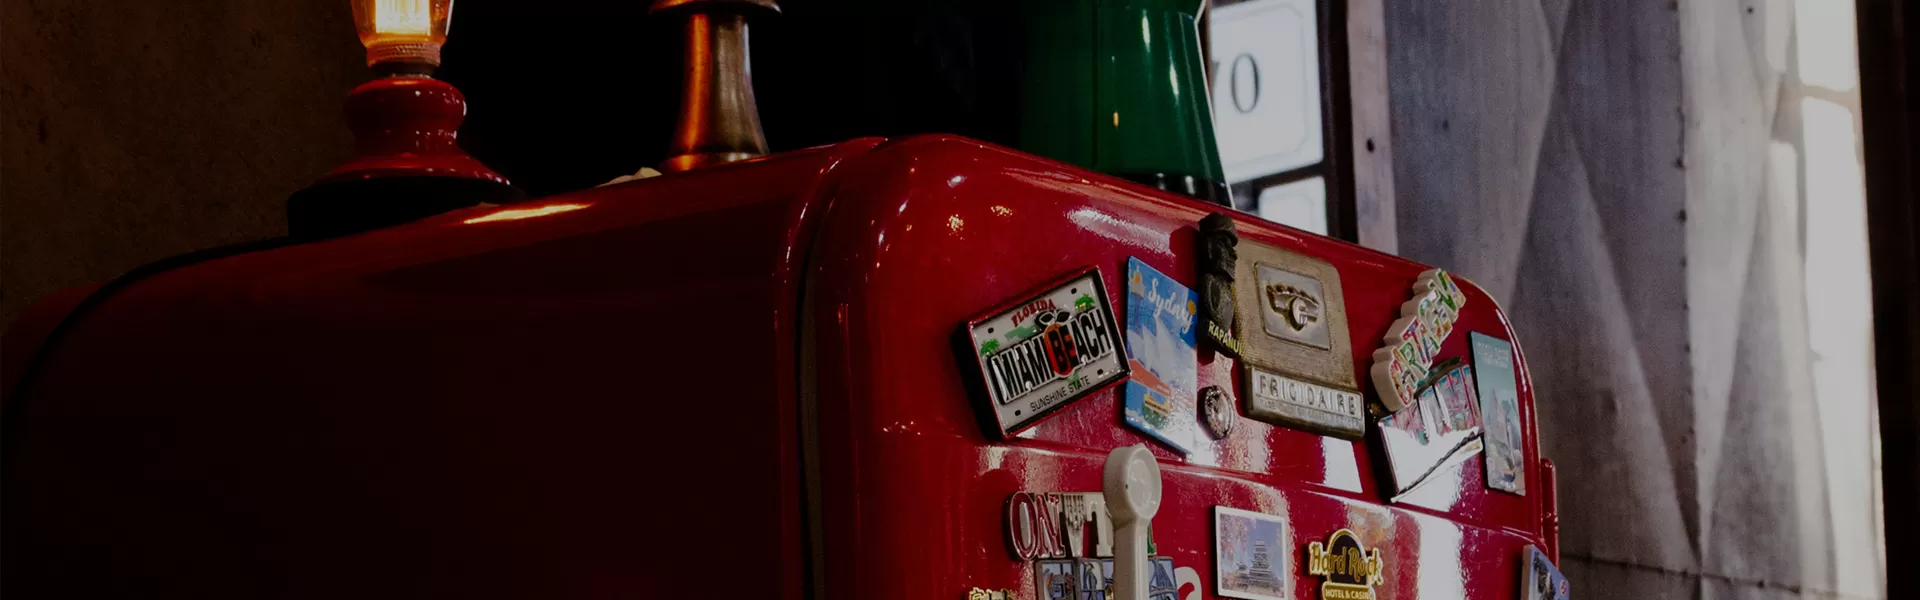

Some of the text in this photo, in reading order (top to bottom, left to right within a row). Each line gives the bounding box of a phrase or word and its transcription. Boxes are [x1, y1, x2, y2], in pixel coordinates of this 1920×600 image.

[1011, 298, 1056, 327] FLORIDA
[1148, 279, 1194, 334] Sydney
[990, 309, 1113, 402] MIAMI BEACH
[1030, 375, 1091, 412] SUNSHINE STATE
[1260, 374, 1356, 416] FRIGIDAIRE
[1310, 543, 1384, 585] Hard Rock
[1325, 588, 1345, 599] HOTEL
